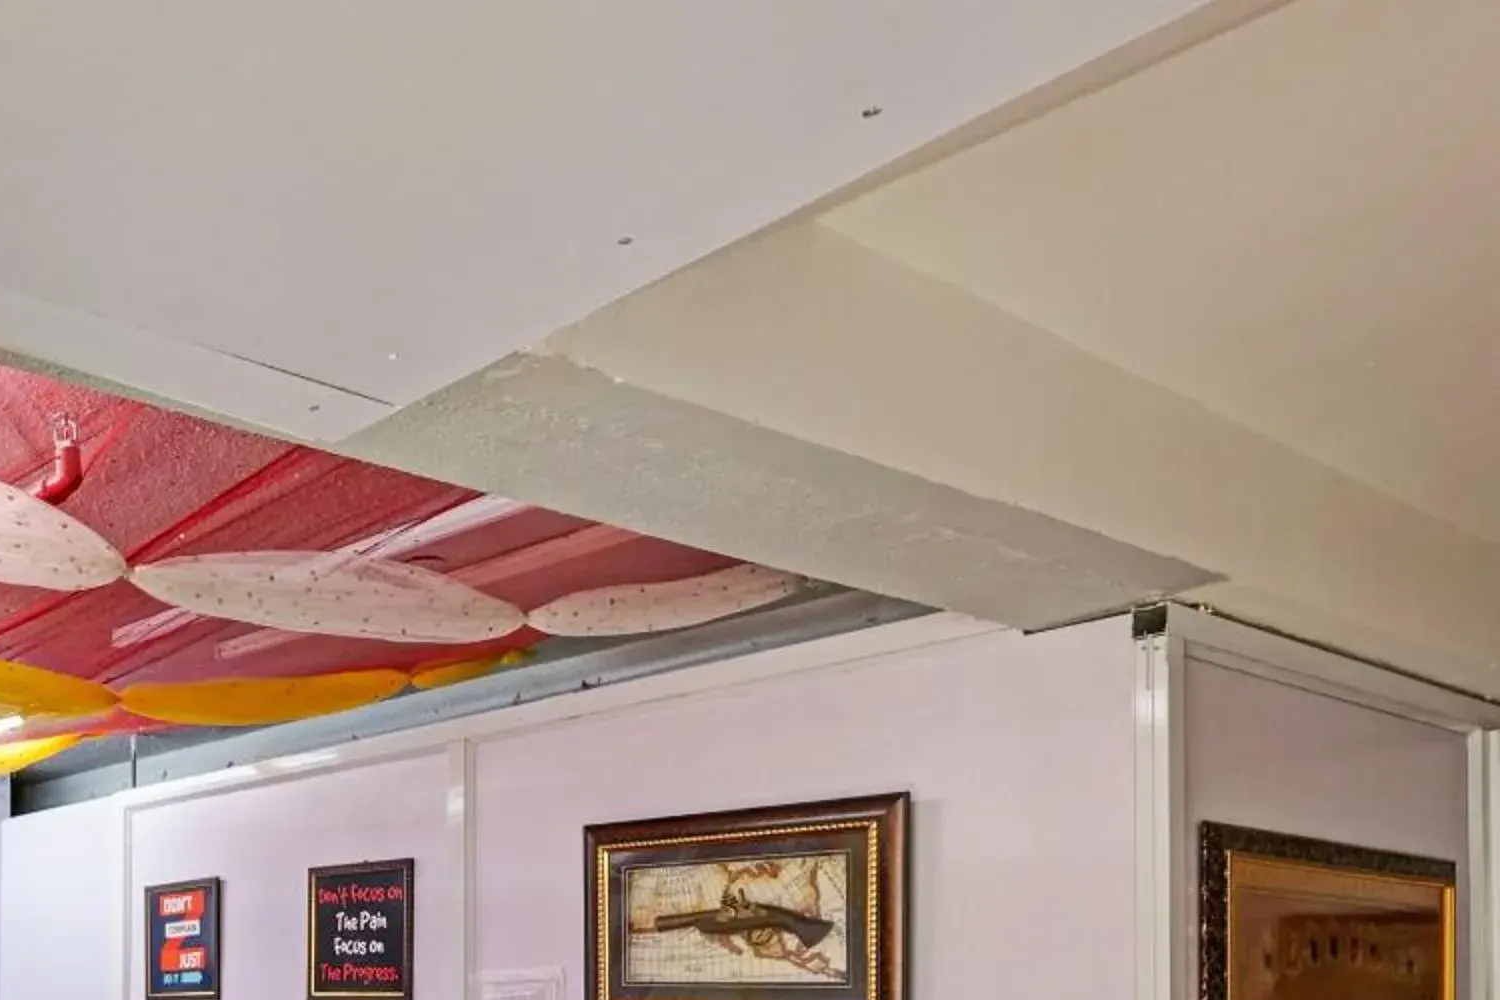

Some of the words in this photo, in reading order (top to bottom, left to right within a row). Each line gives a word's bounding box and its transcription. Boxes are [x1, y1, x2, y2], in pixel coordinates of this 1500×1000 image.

[352, 884, 385, 903] Focus
[335, 911, 358, 932] The
[360, 910, 388, 931] Pain
[333, 937, 367, 955] Focus
[369, 939, 385, 953] on
[179, 951, 202, 969] JUST
[321, 961, 342, 982] The
